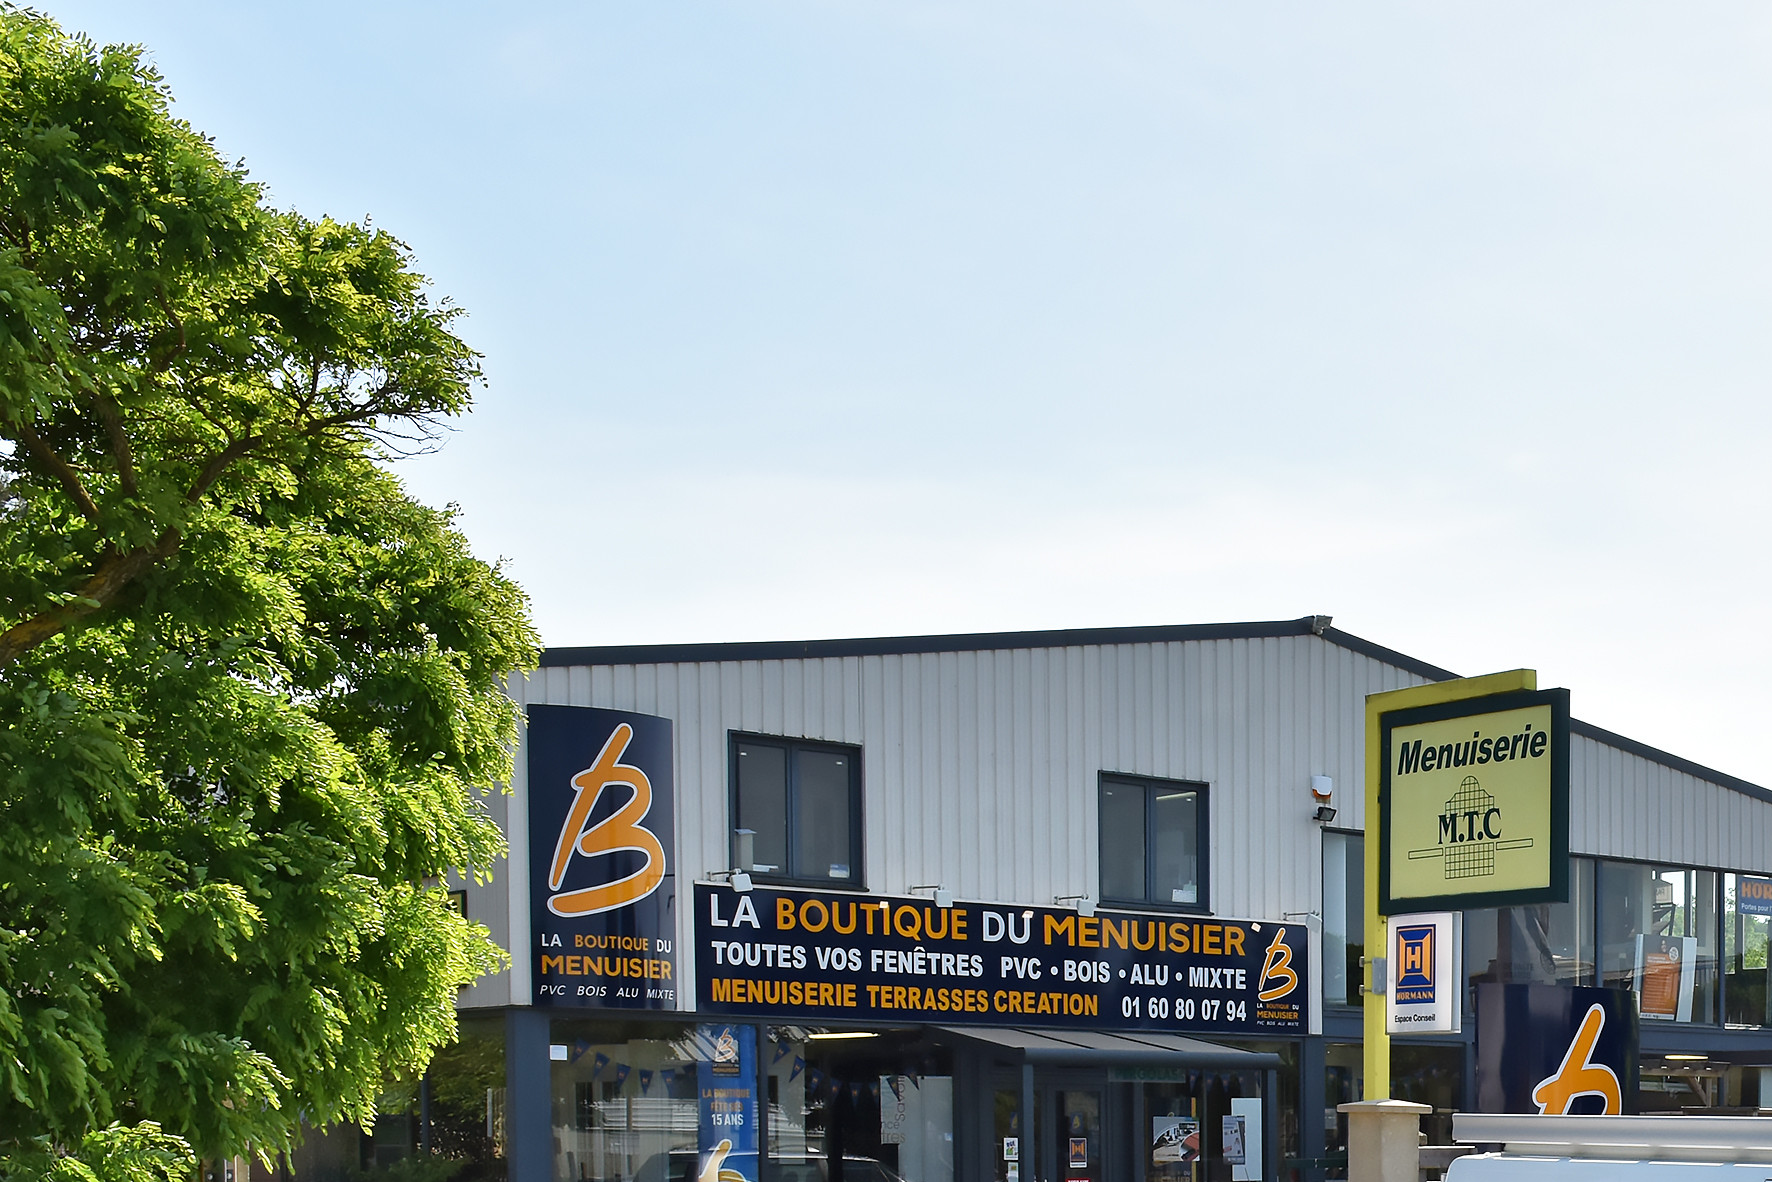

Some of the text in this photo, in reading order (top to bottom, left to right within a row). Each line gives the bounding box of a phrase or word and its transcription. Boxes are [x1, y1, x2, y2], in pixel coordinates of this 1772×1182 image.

[1397, 723, 1548, 776] Menuiserie
[1438, 808, 1502, 845] M.T.C
[710, 893, 1246, 956] LA BOUTIQUE DU MENUISIER
[541, 933, 673, 954] LA BOUTIQUE DU
[541, 954, 673, 981] MENUISIER
[711, 941, 1247, 989] TOUTES VOS FENÊTRES PVC BOIS ALU MIXTE
[539, 984, 674, 1000] PVC BOIS ALU MIXTE
[711, 978, 1247, 1022] MENUISERIE TERRASSES CREATION 01 60 80 07 94
[1256, 1010, 1299, 1019] MENUISIER
[1394, 1013, 1436, 1024] Espace Conseil
[711, 1113, 744, 1126] 15 ANS
